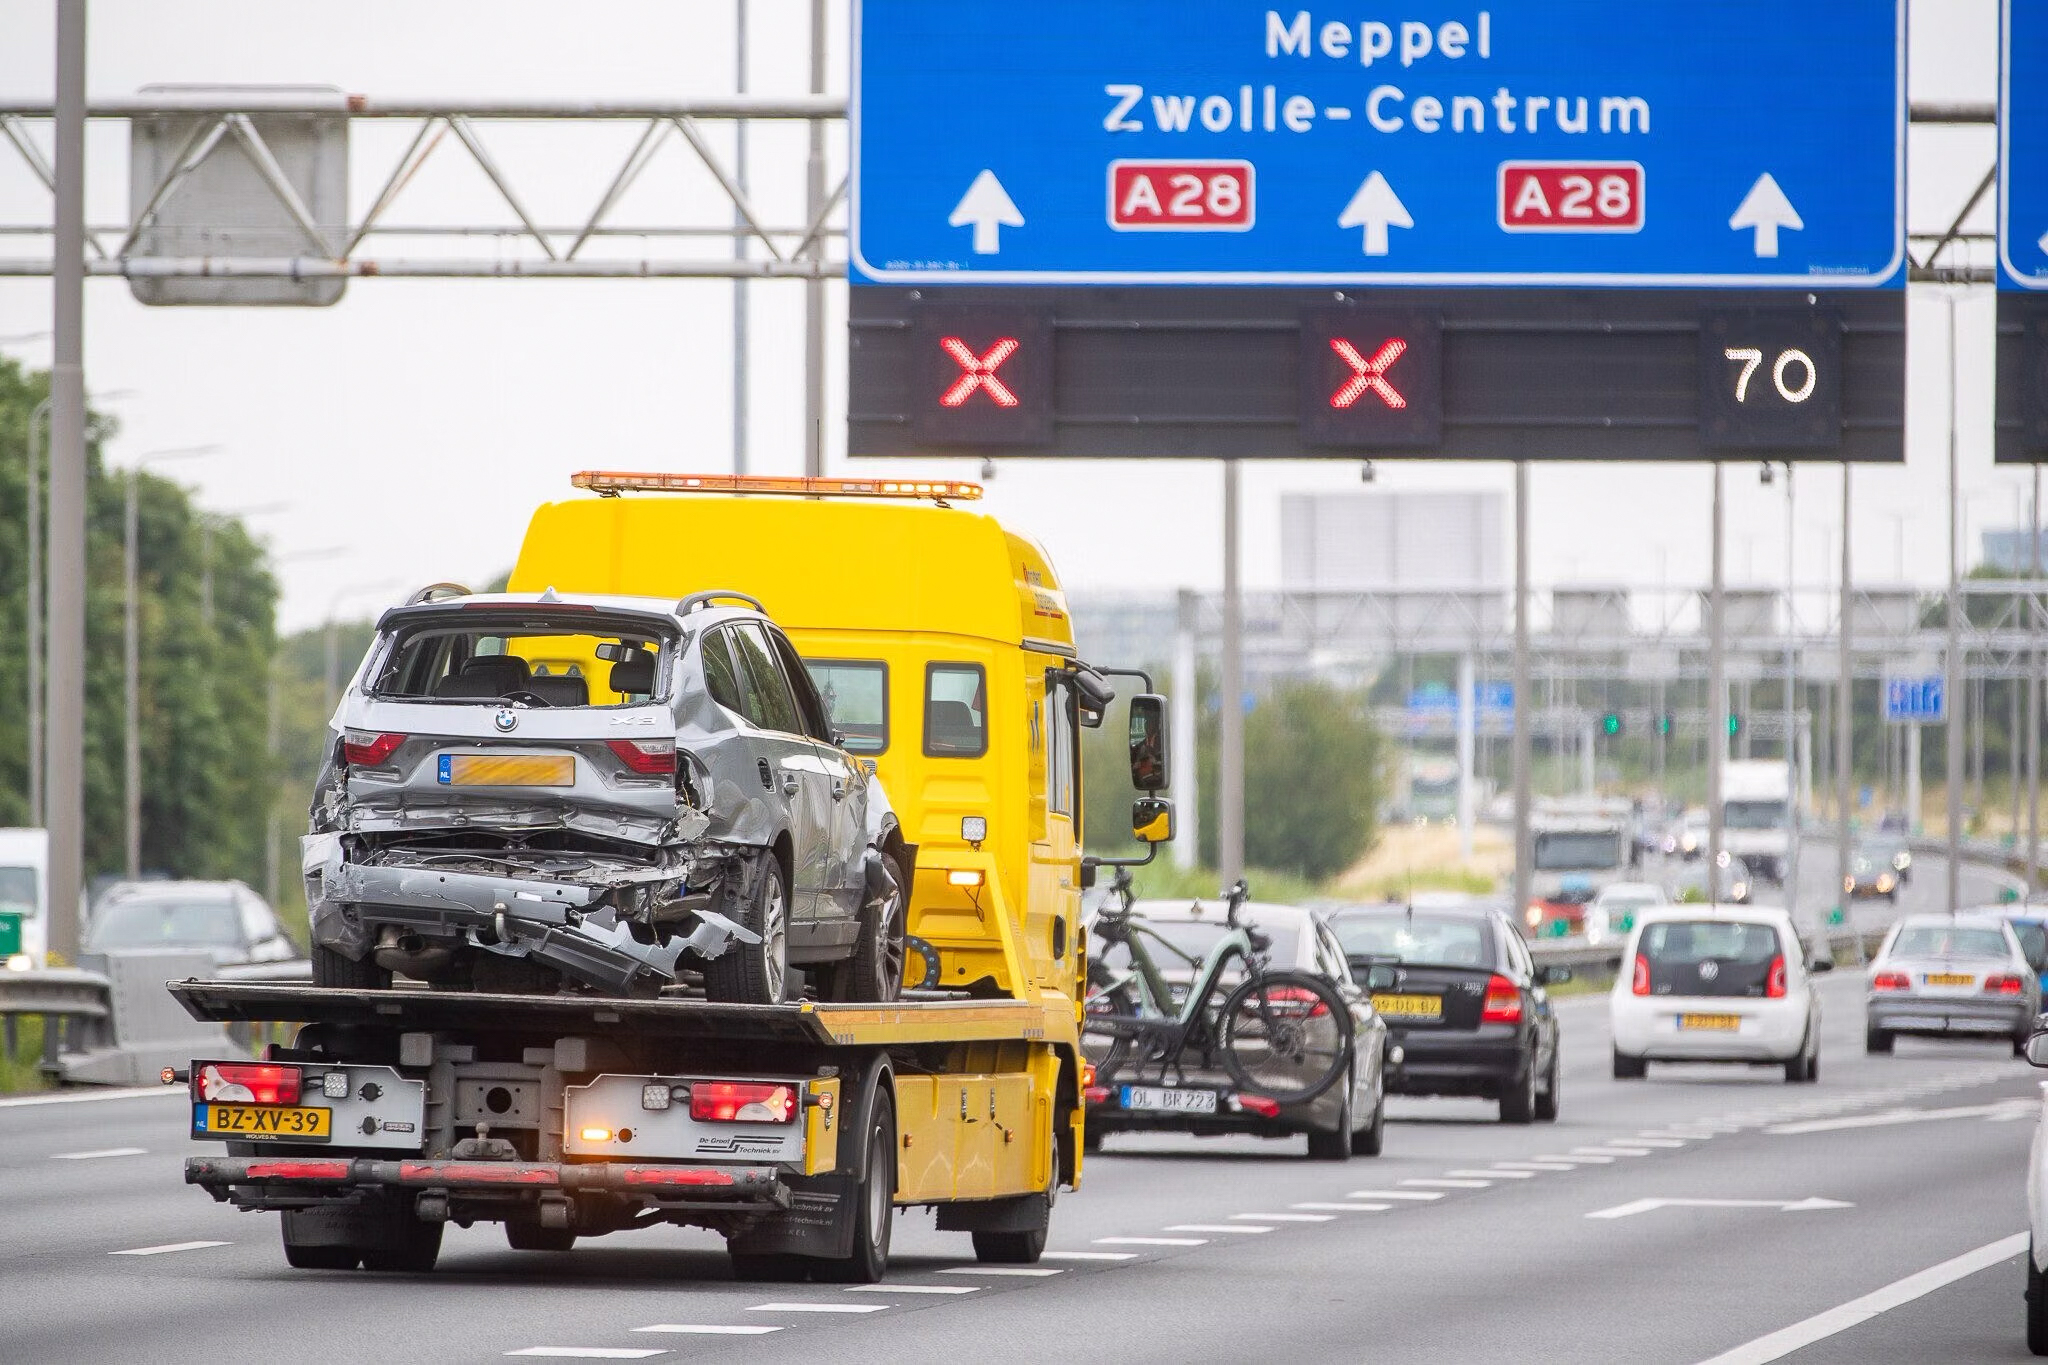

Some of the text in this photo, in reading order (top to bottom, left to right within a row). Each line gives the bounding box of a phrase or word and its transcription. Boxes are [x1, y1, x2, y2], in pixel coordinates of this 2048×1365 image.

[1265, 10, 1491, 68] Meppel
[1725, 347, 1817, 403] 70
[609, 716, 657, 726] X3
[440, 771, 450, 779] NL
[1133, 1090, 1152, 1107] OL
[217, 1108, 319, 1132] BZ-XV-39
[711, 1137, 731, 1145] Groot
[740, 1146, 771, 1154] Techniek
